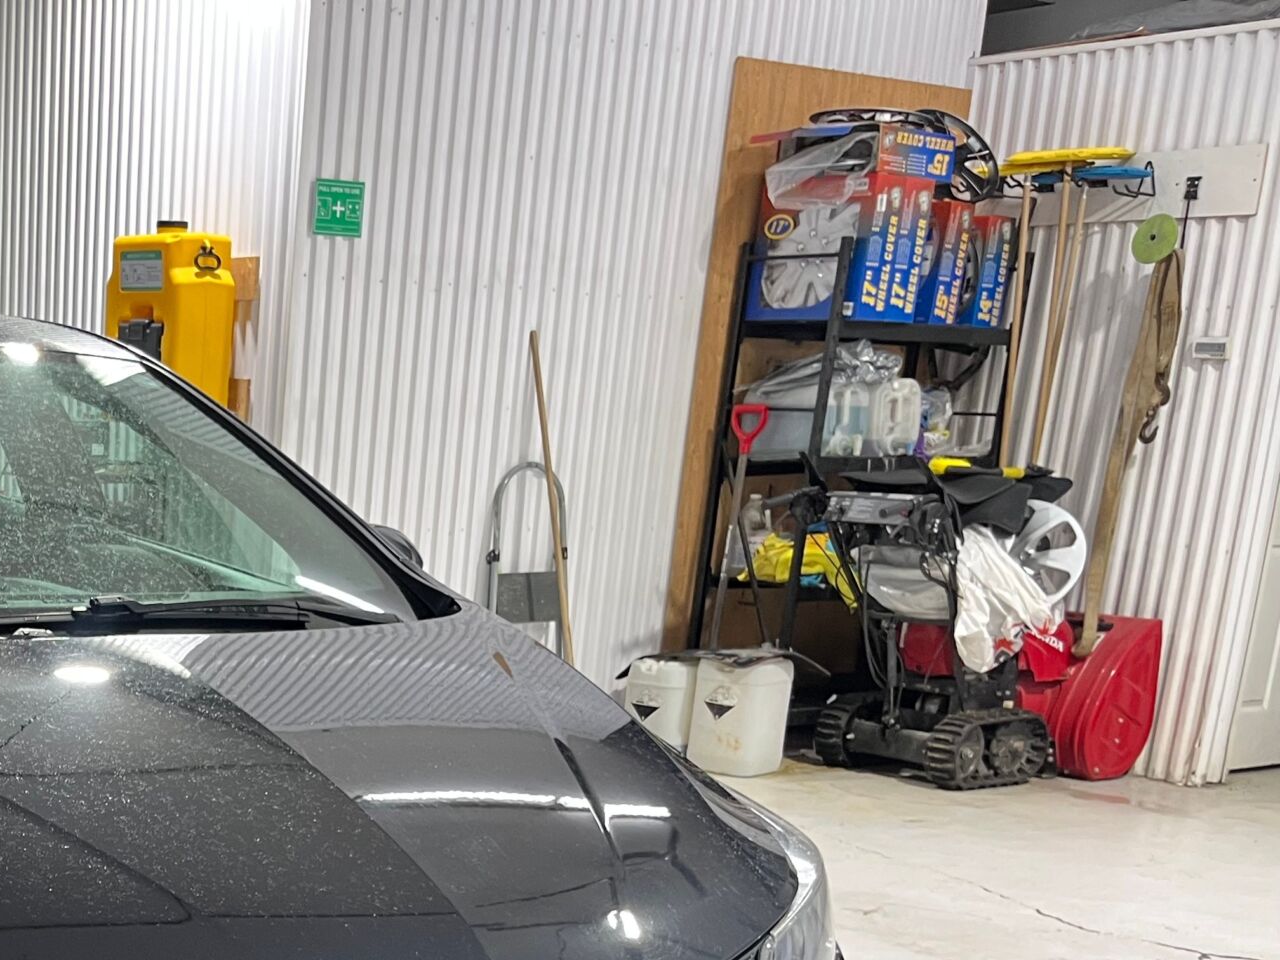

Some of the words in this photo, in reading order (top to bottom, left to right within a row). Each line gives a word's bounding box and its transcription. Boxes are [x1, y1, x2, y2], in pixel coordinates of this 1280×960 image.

[896, 131, 924, 147] COVER
[925, 136, 954, 152] WHEEL
[861, 270, 877, 306] 17"
[875, 264, 891, 312] WHEEL
[884, 215, 899, 261] COVER
[890, 272, 906, 308] 17"
[904, 266, 919, 313] WHEEL
[913, 218, 927, 264] COVER
[946, 278, 960, 324] WHEEL
[955, 231, 970, 276] COVER
[990, 284, 1004, 326] WHEEL
[998, 243, 1010, 283] COVER
